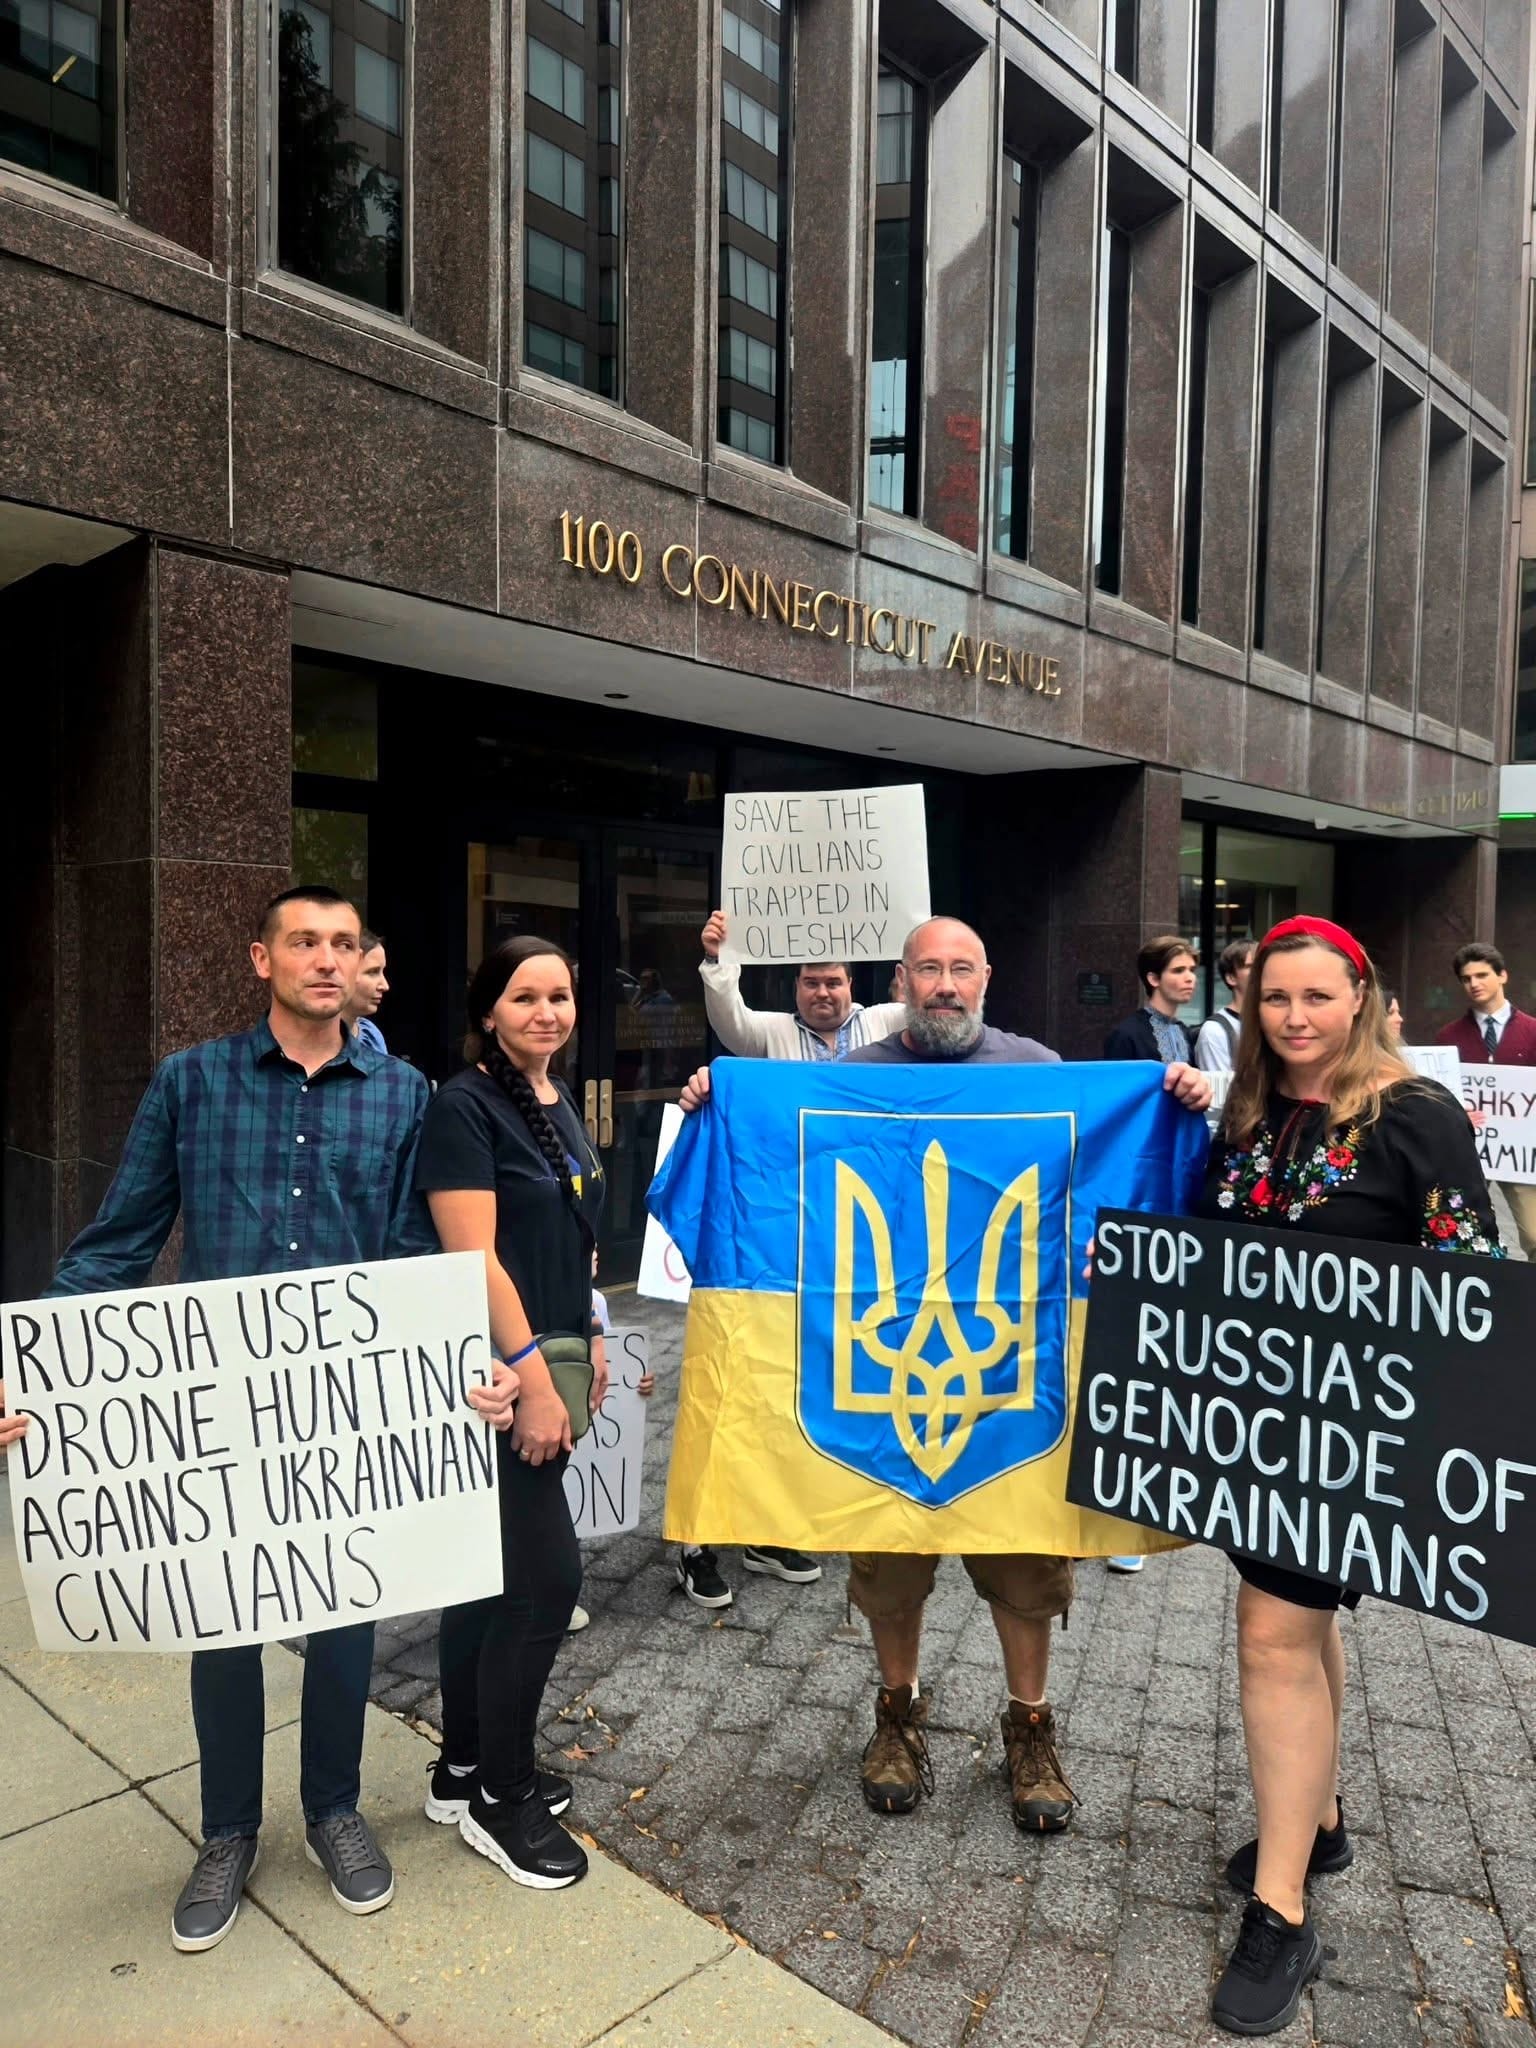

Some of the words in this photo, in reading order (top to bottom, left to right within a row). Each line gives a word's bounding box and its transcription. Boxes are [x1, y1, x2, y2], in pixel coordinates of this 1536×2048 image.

[559, 510, 643, 583] 1100
[662, 544, 937, 665] CONNECTICUT
[944, 631, 1062, 696] AVENUE
[734, 799, 804, 833] SAVE
[816, 795, 881, 832] THE
[741, 838, 883, 875] CIVILIANS
[727, 883, 850, 917] TRAPPED
[863, 881, 889, 913] IN
[745, 919, 888, 959] OLESHKY
[10, 1295, 220, 1394] RUSSIA
[237, 1271, 380, 1361] USES
[1097, 1221, 1203, 1287] STOP
[1222, 1238, 1494, 1342] IGNORING
[14, 1383, 231, 1480] DRONE
[245, 1334, 487, 1448] HUNTING
[1137, 1302, 1416, 1421] RUSSIA'S
[22, 1463, 239, 1563] AGAINST
[260, 1420, 495, 1527] UKRAINIAN
[1088, 1372, 1406, 1508] GENOCIDE
[1436, 1447, 1536, 1533] OF
[55, 1526, 383, 1644] CIVILIANS
[1093, 1446, 1490, 1622] UKRAINIANS
